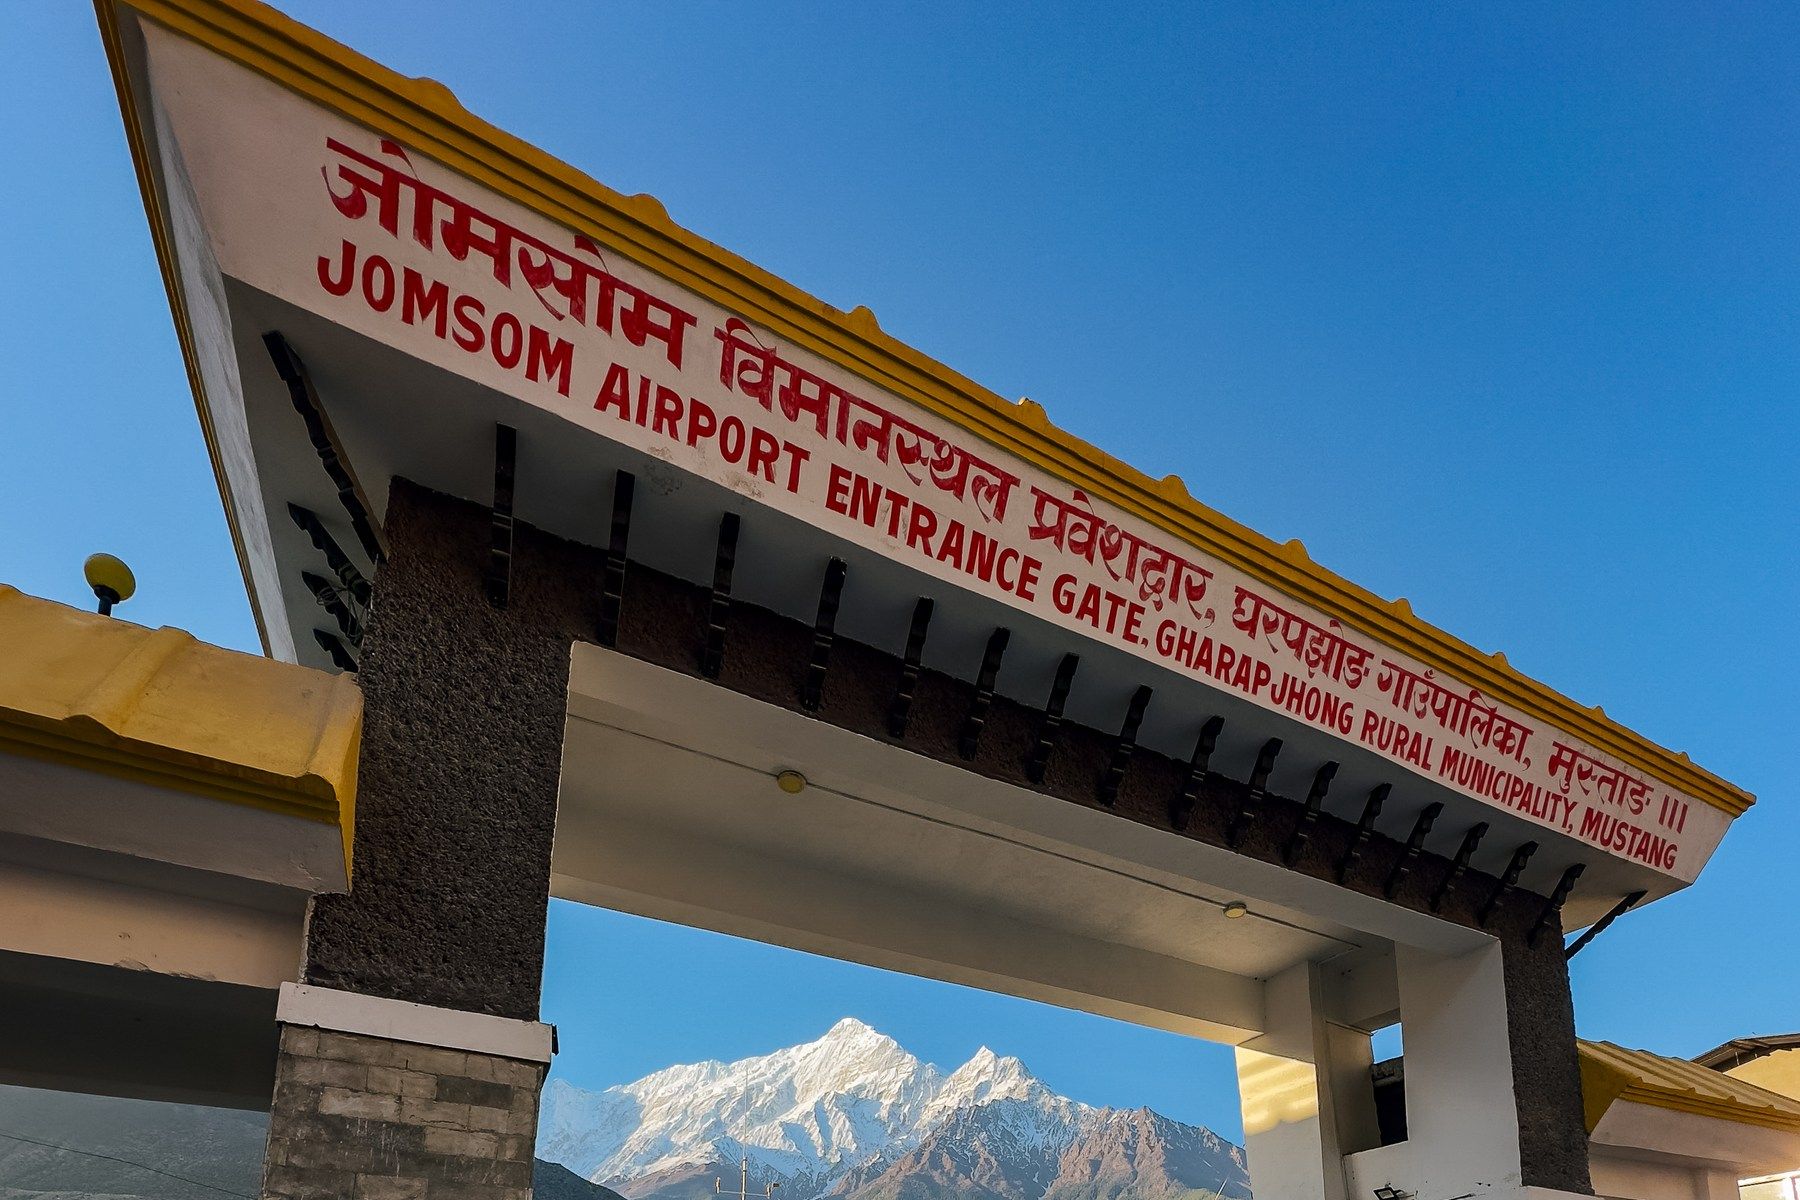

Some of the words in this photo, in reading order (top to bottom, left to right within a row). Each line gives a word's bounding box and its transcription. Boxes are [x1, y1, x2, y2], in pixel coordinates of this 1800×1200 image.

[317, 239, 575, 397] JOMSOM
[593, 362, 811, 494] AIRPORT
[825, 463, 1043, 603] ENTRANCE
[1052, 573, 1149, 649] GATE,
[1155, 618, 1354, 736] GHARAPJHONG
[1360, 709, 1434, 772] RURAL
[1438, 744, 1578, 834] MUNICIPALITY,
[1578, 806, 1678, 870] MUSTANG
[321, 136, 698, 372] जोमसोम
[714, 316, 1021, 524] विमानस्थल
